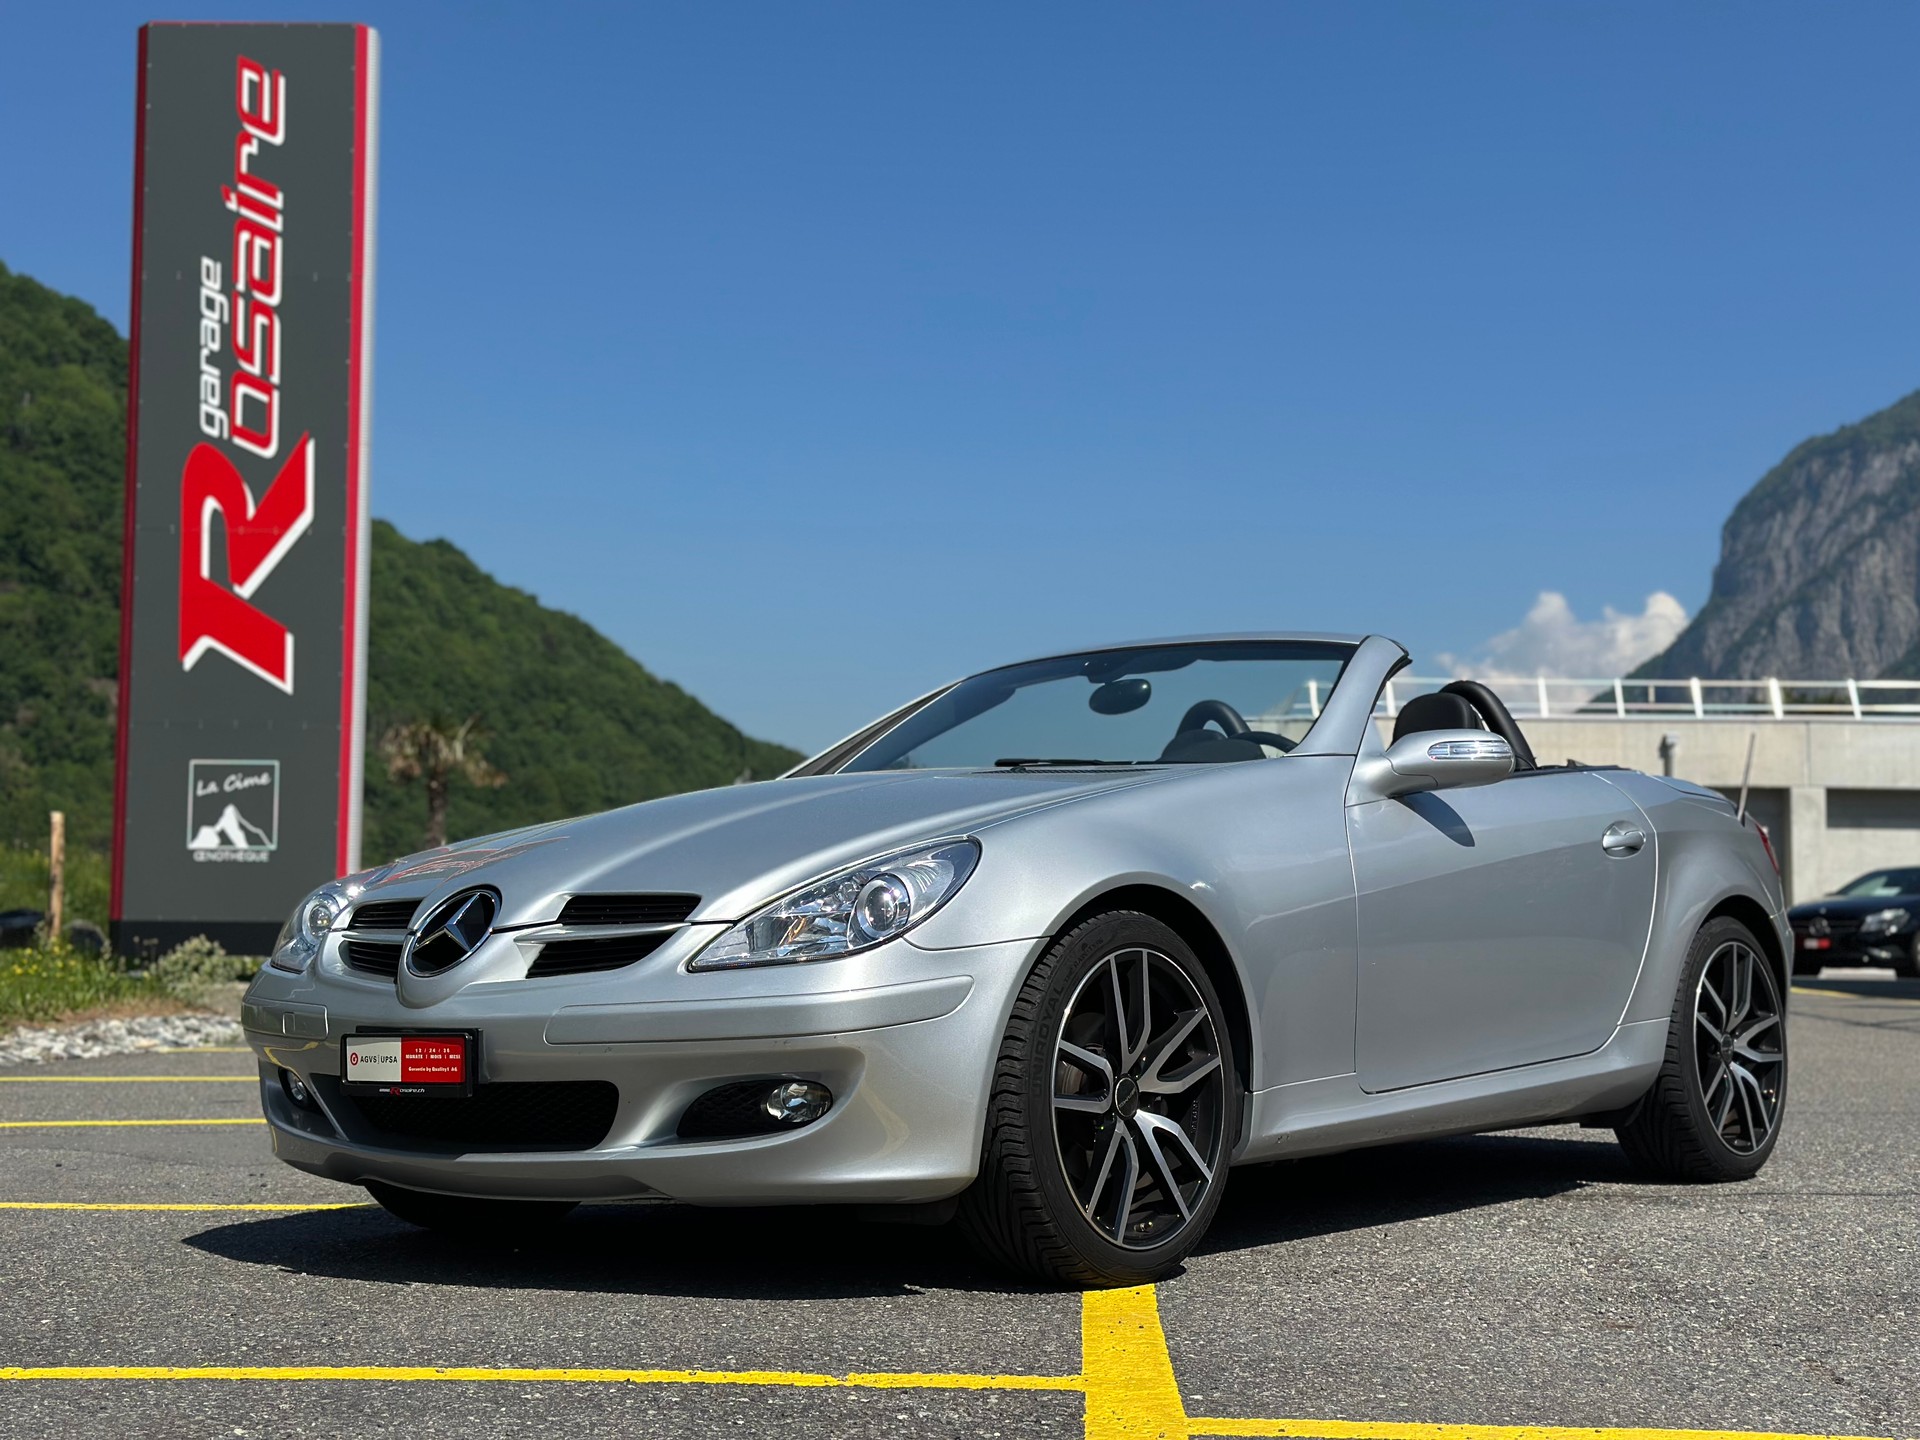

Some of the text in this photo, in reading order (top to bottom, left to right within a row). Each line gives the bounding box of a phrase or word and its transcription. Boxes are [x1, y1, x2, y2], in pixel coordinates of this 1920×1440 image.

[178, 54, 315, 694] Rosaire
[200, 256, 229, 438] garage
[196, 771, 271, 797] La Cime
[360, 1055, 398, 1063] AGVS UPSA
